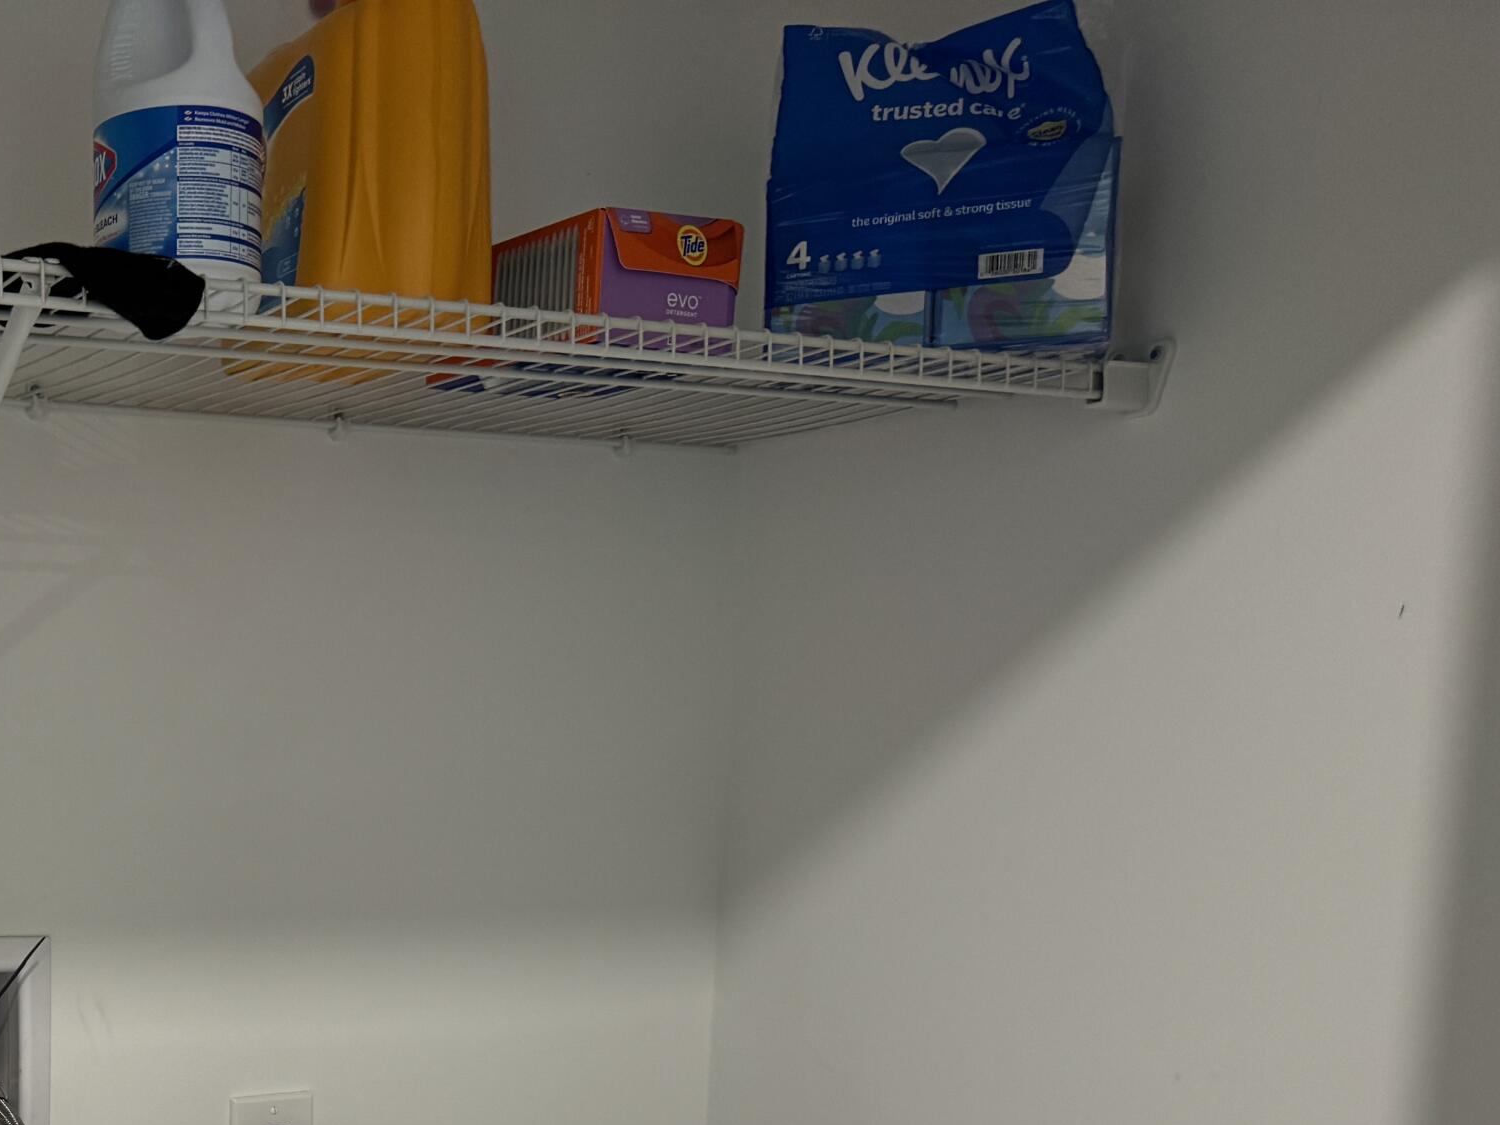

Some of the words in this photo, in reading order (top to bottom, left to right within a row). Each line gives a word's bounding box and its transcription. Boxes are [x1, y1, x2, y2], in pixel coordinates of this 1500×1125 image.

[870, 98, 964, 122] trusted
[851, 217, 870, 228] the
[872, 212, 916, 226] original
[917, 208, 941, 220] soft
[944, 206, 953, 217] &
[955, 202, 994, 216] strong
[995, 198, 1033, 211] tissue
[680, 235, 705, 257] Tide
[786, 240, 812, 270] 4
[667, 292, 699, 310] evo
